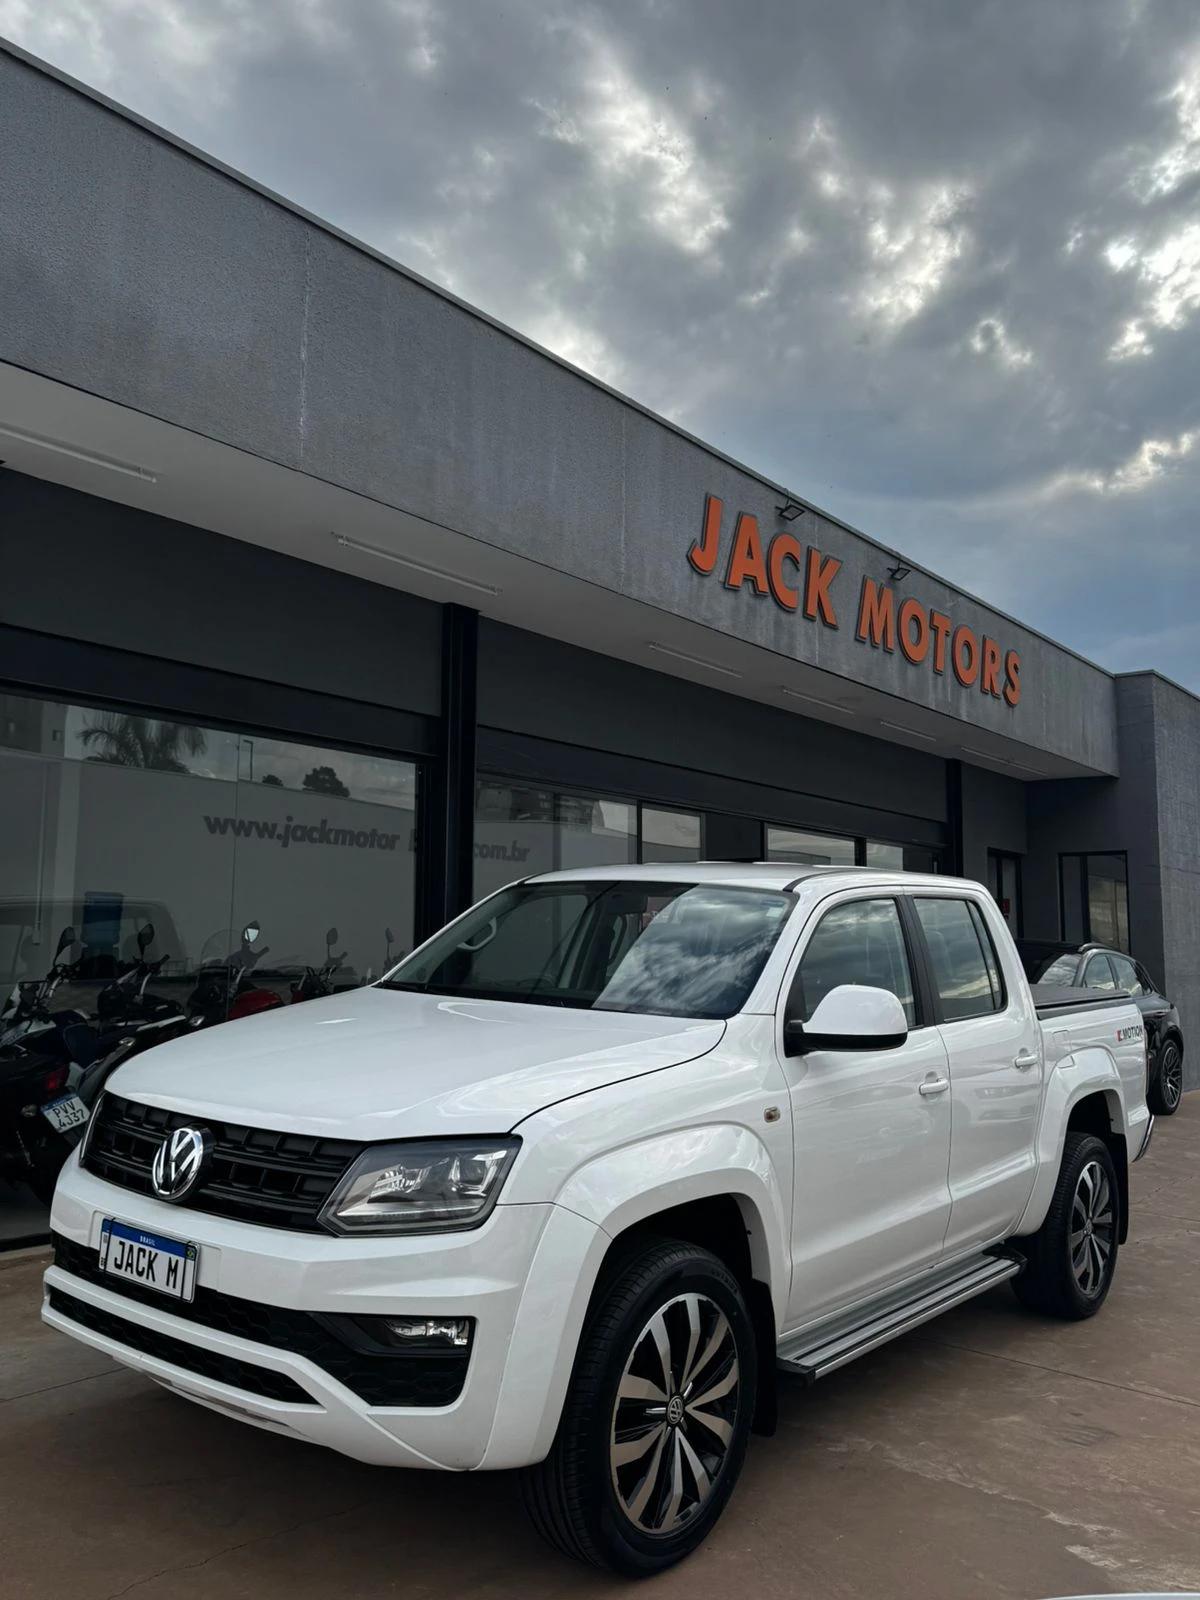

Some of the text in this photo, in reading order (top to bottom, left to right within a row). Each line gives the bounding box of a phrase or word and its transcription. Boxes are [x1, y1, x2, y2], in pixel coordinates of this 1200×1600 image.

[687, 494, 1022, 706] JACK MOTORS
[203, 815, 401, 851] www.jackmotor
[114, 1240, 179, 1289] JACK M
